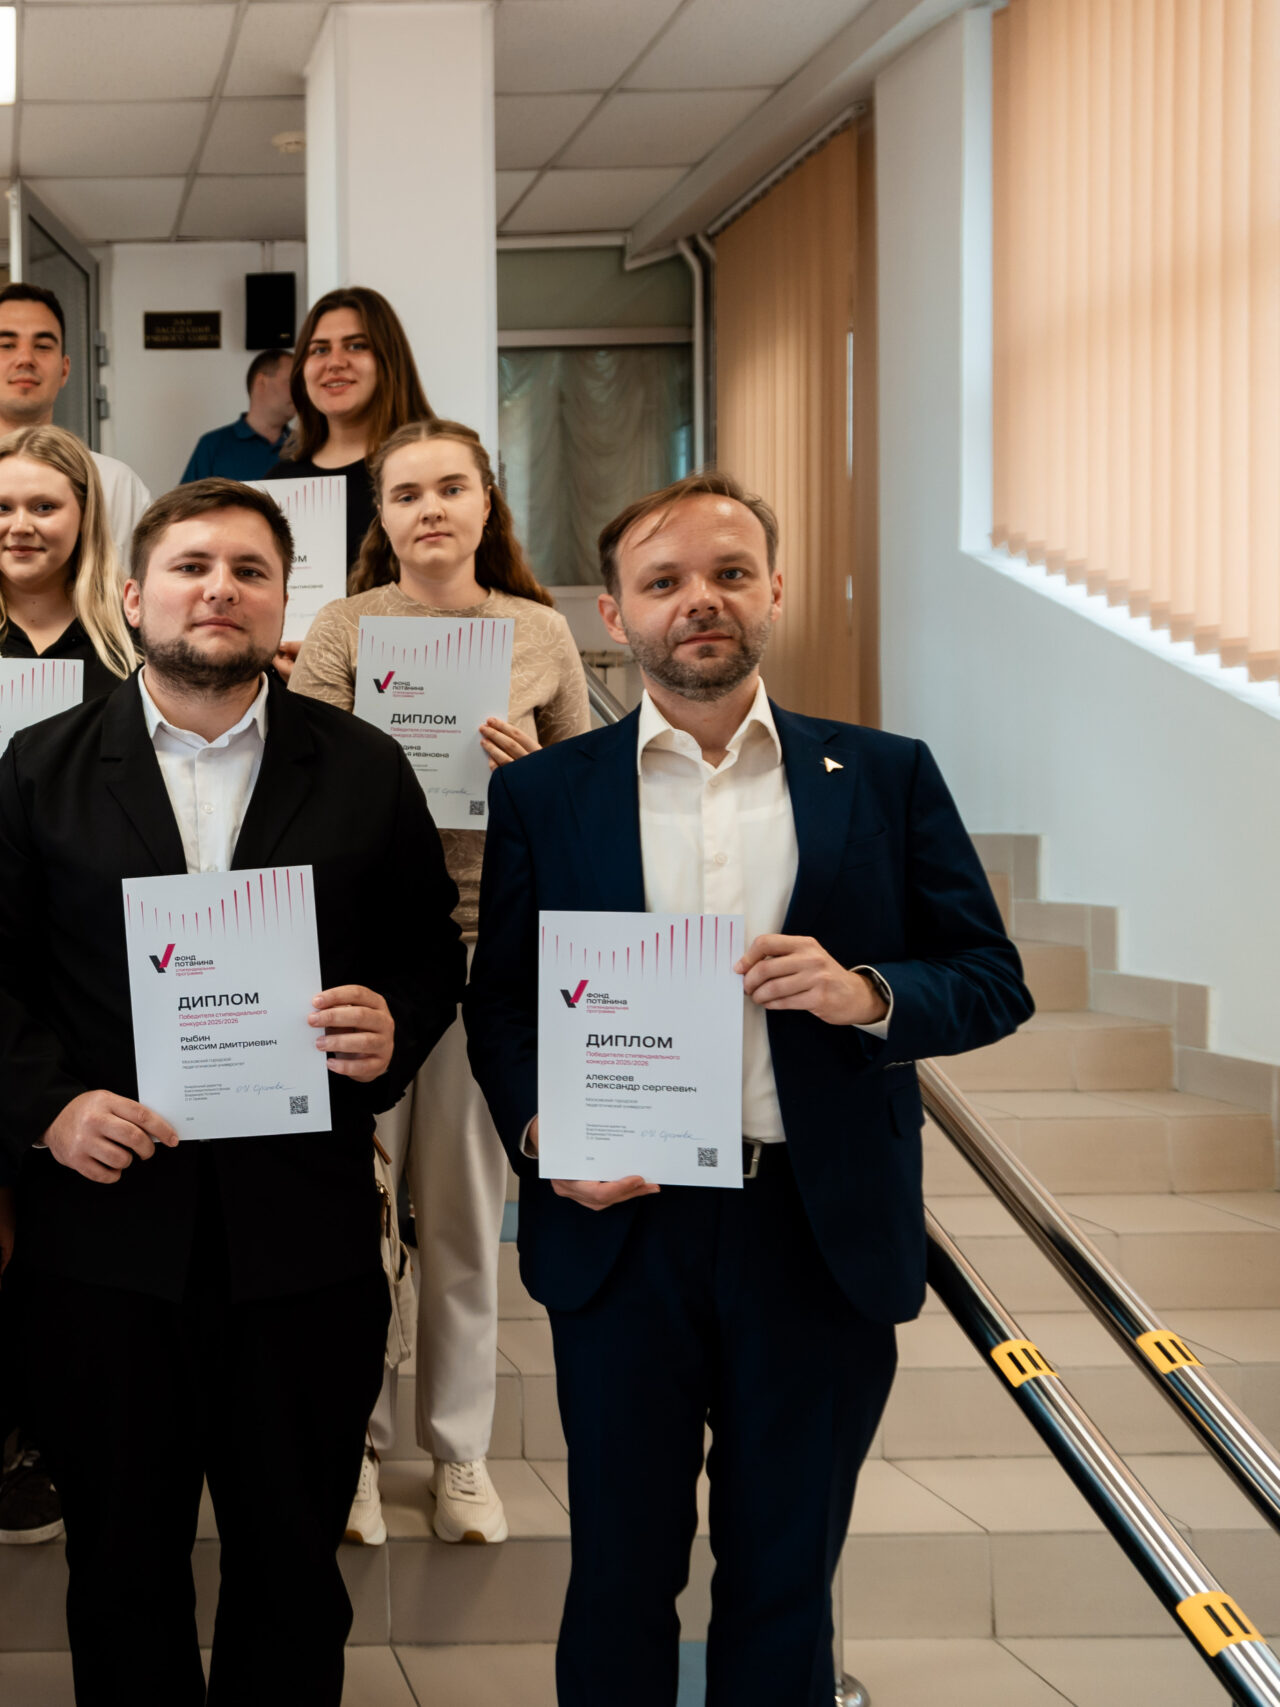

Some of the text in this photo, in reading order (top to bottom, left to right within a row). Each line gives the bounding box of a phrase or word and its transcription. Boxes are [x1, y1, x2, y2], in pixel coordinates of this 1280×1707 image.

[391, 714, 456, 725] ДИПЛОМ
[178, 992, 259, 1011] ДИПЛОМ
[215, 1009, 267, 1018] стипендиального
[586, 1034, 672, 1048] ДИПЛОМ
[586, 1074, 634, 1082] Алексеев
[586, 1083, 640, 1092] Александр
